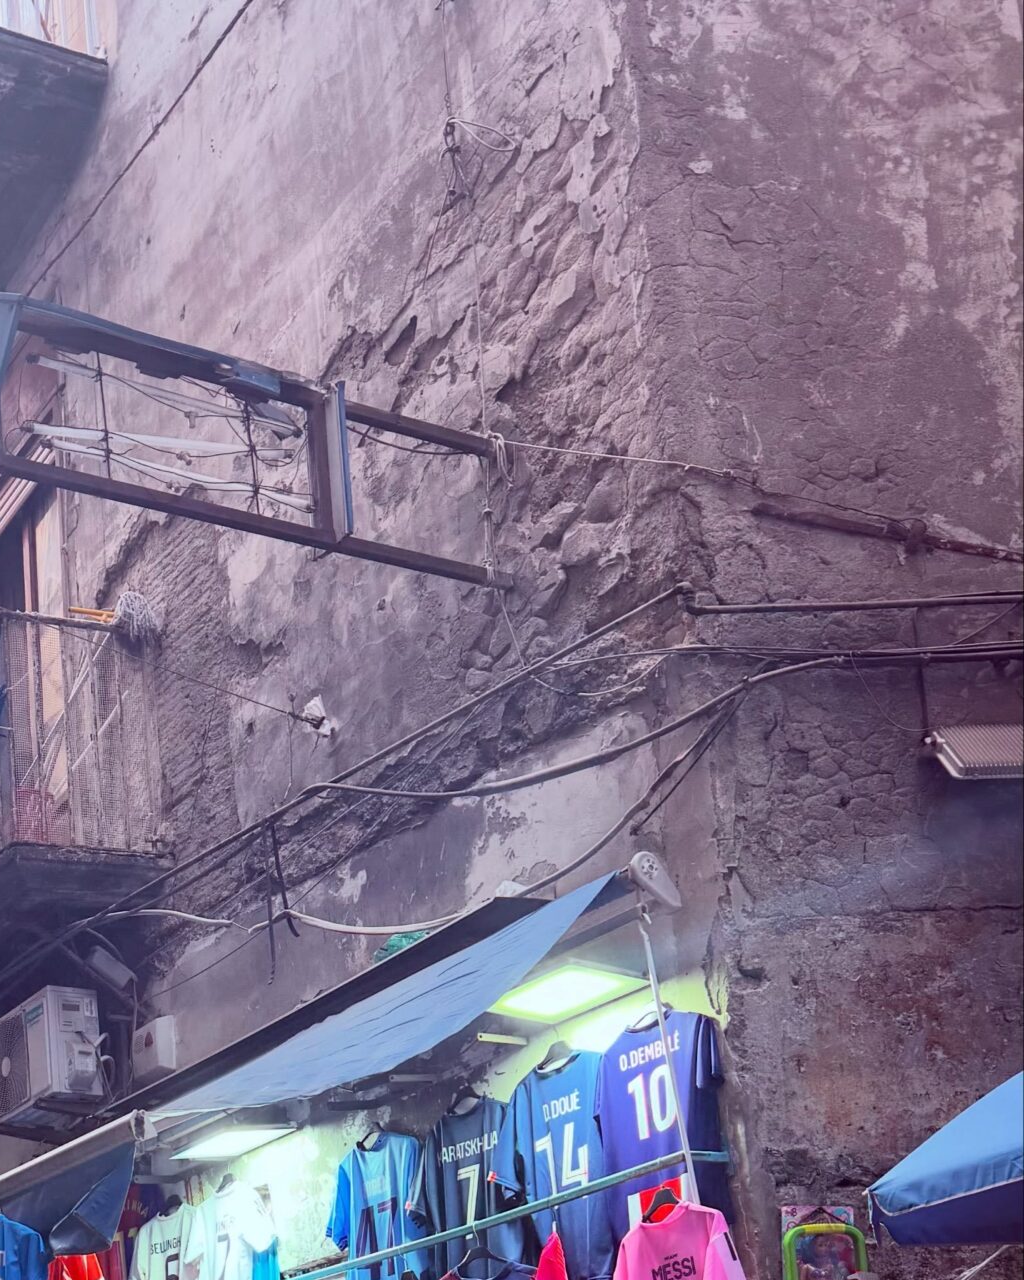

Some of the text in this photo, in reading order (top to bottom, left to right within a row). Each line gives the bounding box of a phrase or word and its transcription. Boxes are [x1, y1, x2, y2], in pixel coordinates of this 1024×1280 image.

[619, 1030, 680, 1072] O.DEMBLÉ
[543, 1089, 581, 1122] D.DOUÉ
[628, 1064, 677, 1140] 10
[535, 1122, 588, 1198] 14
[457, 1164, 480, 1240] 7
